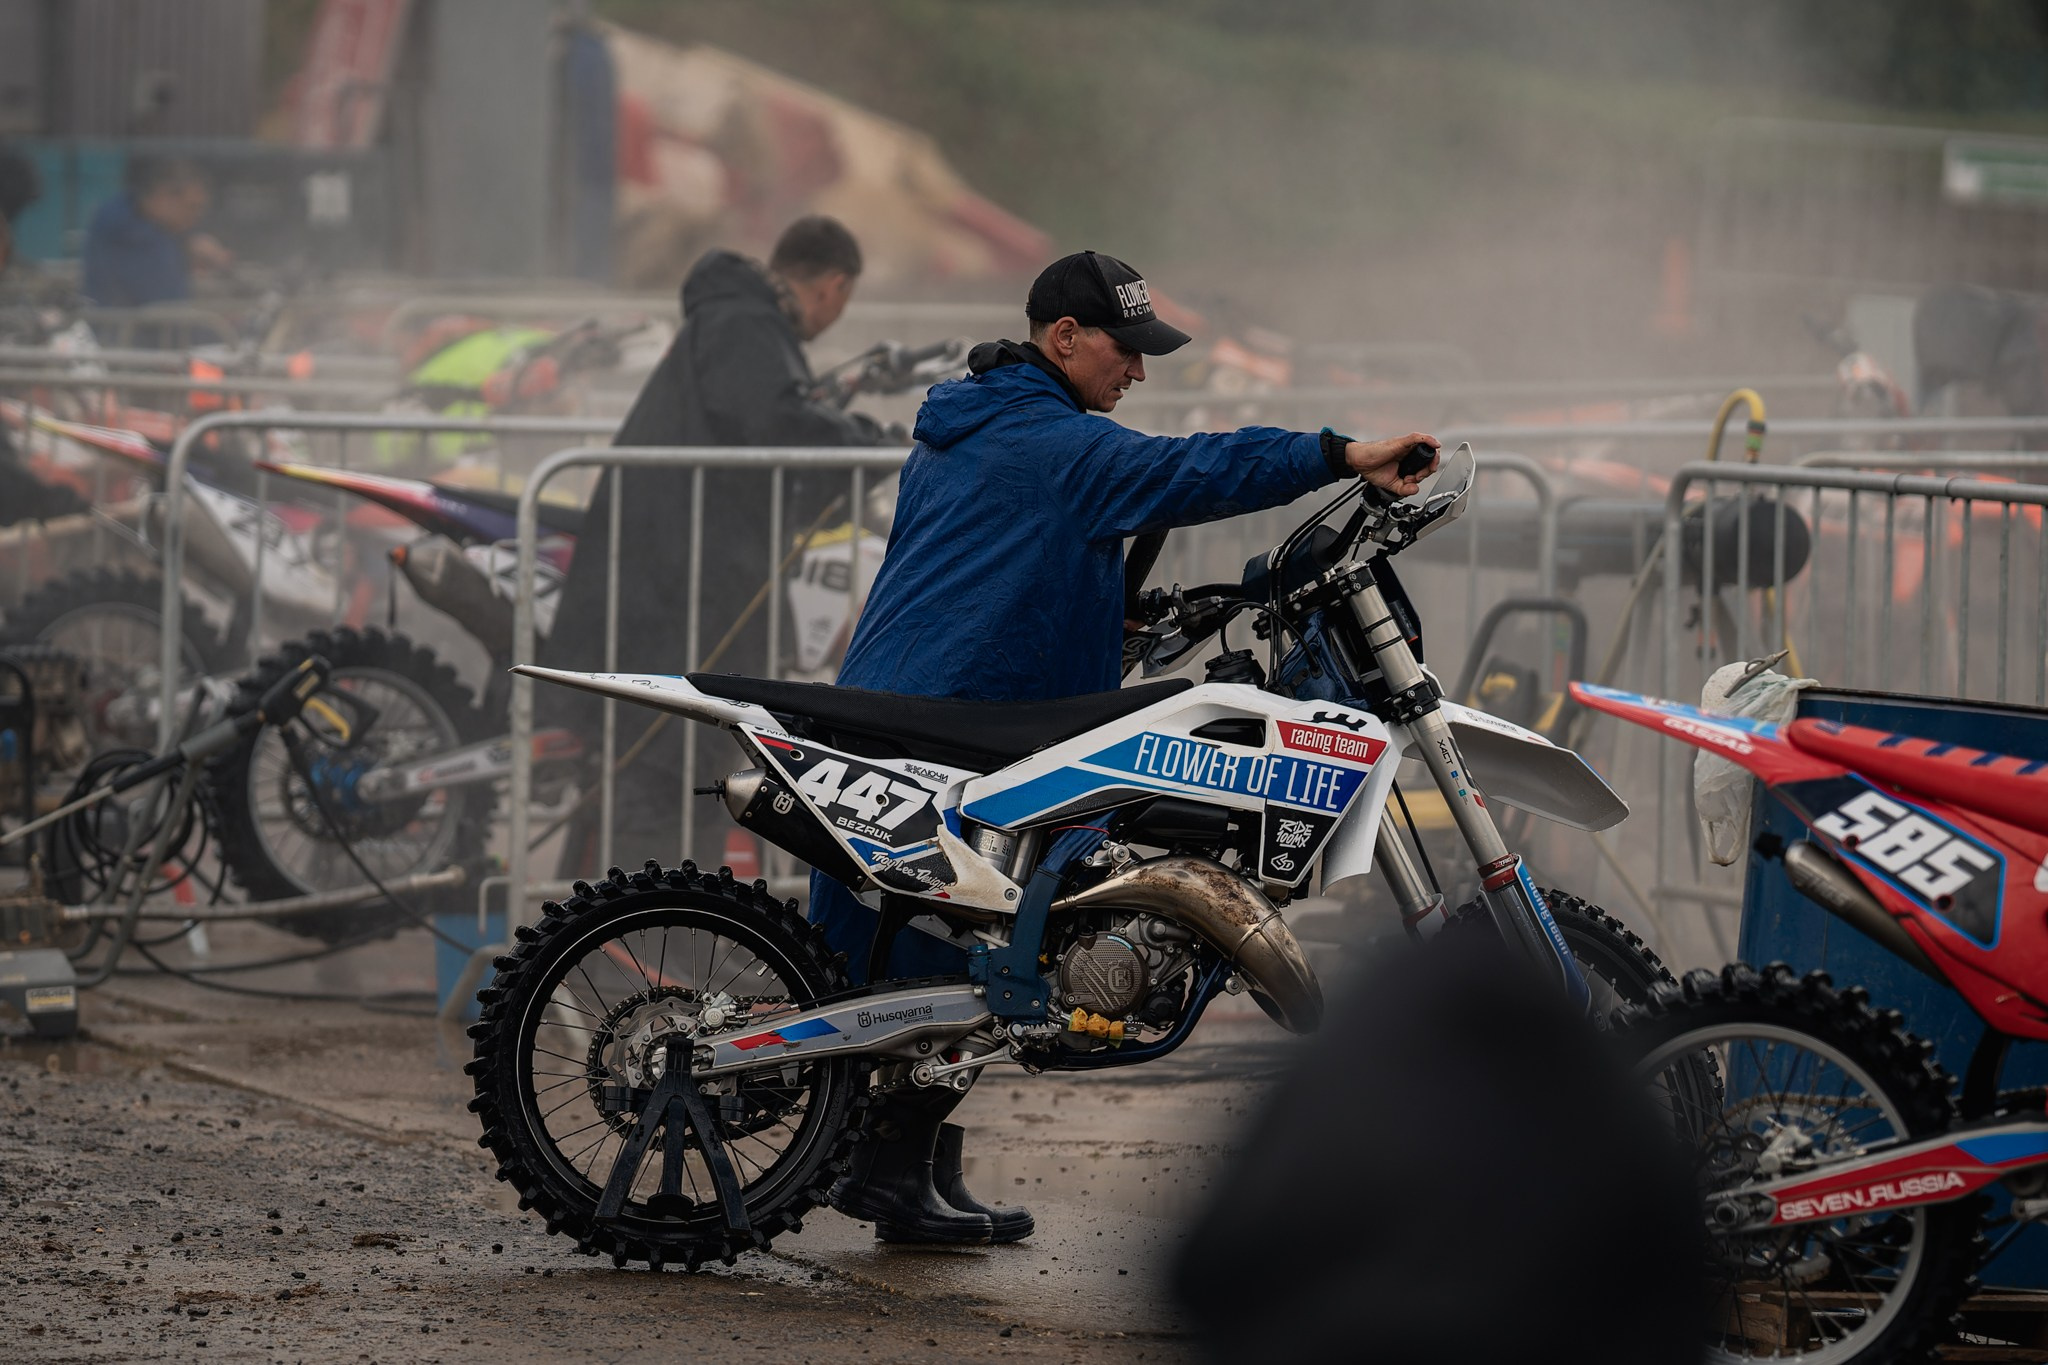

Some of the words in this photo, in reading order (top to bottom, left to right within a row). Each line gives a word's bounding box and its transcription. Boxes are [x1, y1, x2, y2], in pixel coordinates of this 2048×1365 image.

[1290, 728, 1334, 754] racing
[1334, 734, 1369, 758] team
[1663, 717, 1755, 755] GASGAS
[1134, 734, 1241, 789] FLOWER
[1247, 755, 1285, 796] OF
[1285, 761, 1345, 810] LIFE
[796, 757, 932, 831] 447
[836, 816, 893, 843] BEZRUK
[1812, 790, 1996, 901] 585
[872, 851, 897, 872] Troy
[895, 860, 915, 877] Lee
[872, 1004, 933, 1024] Husqvarna
